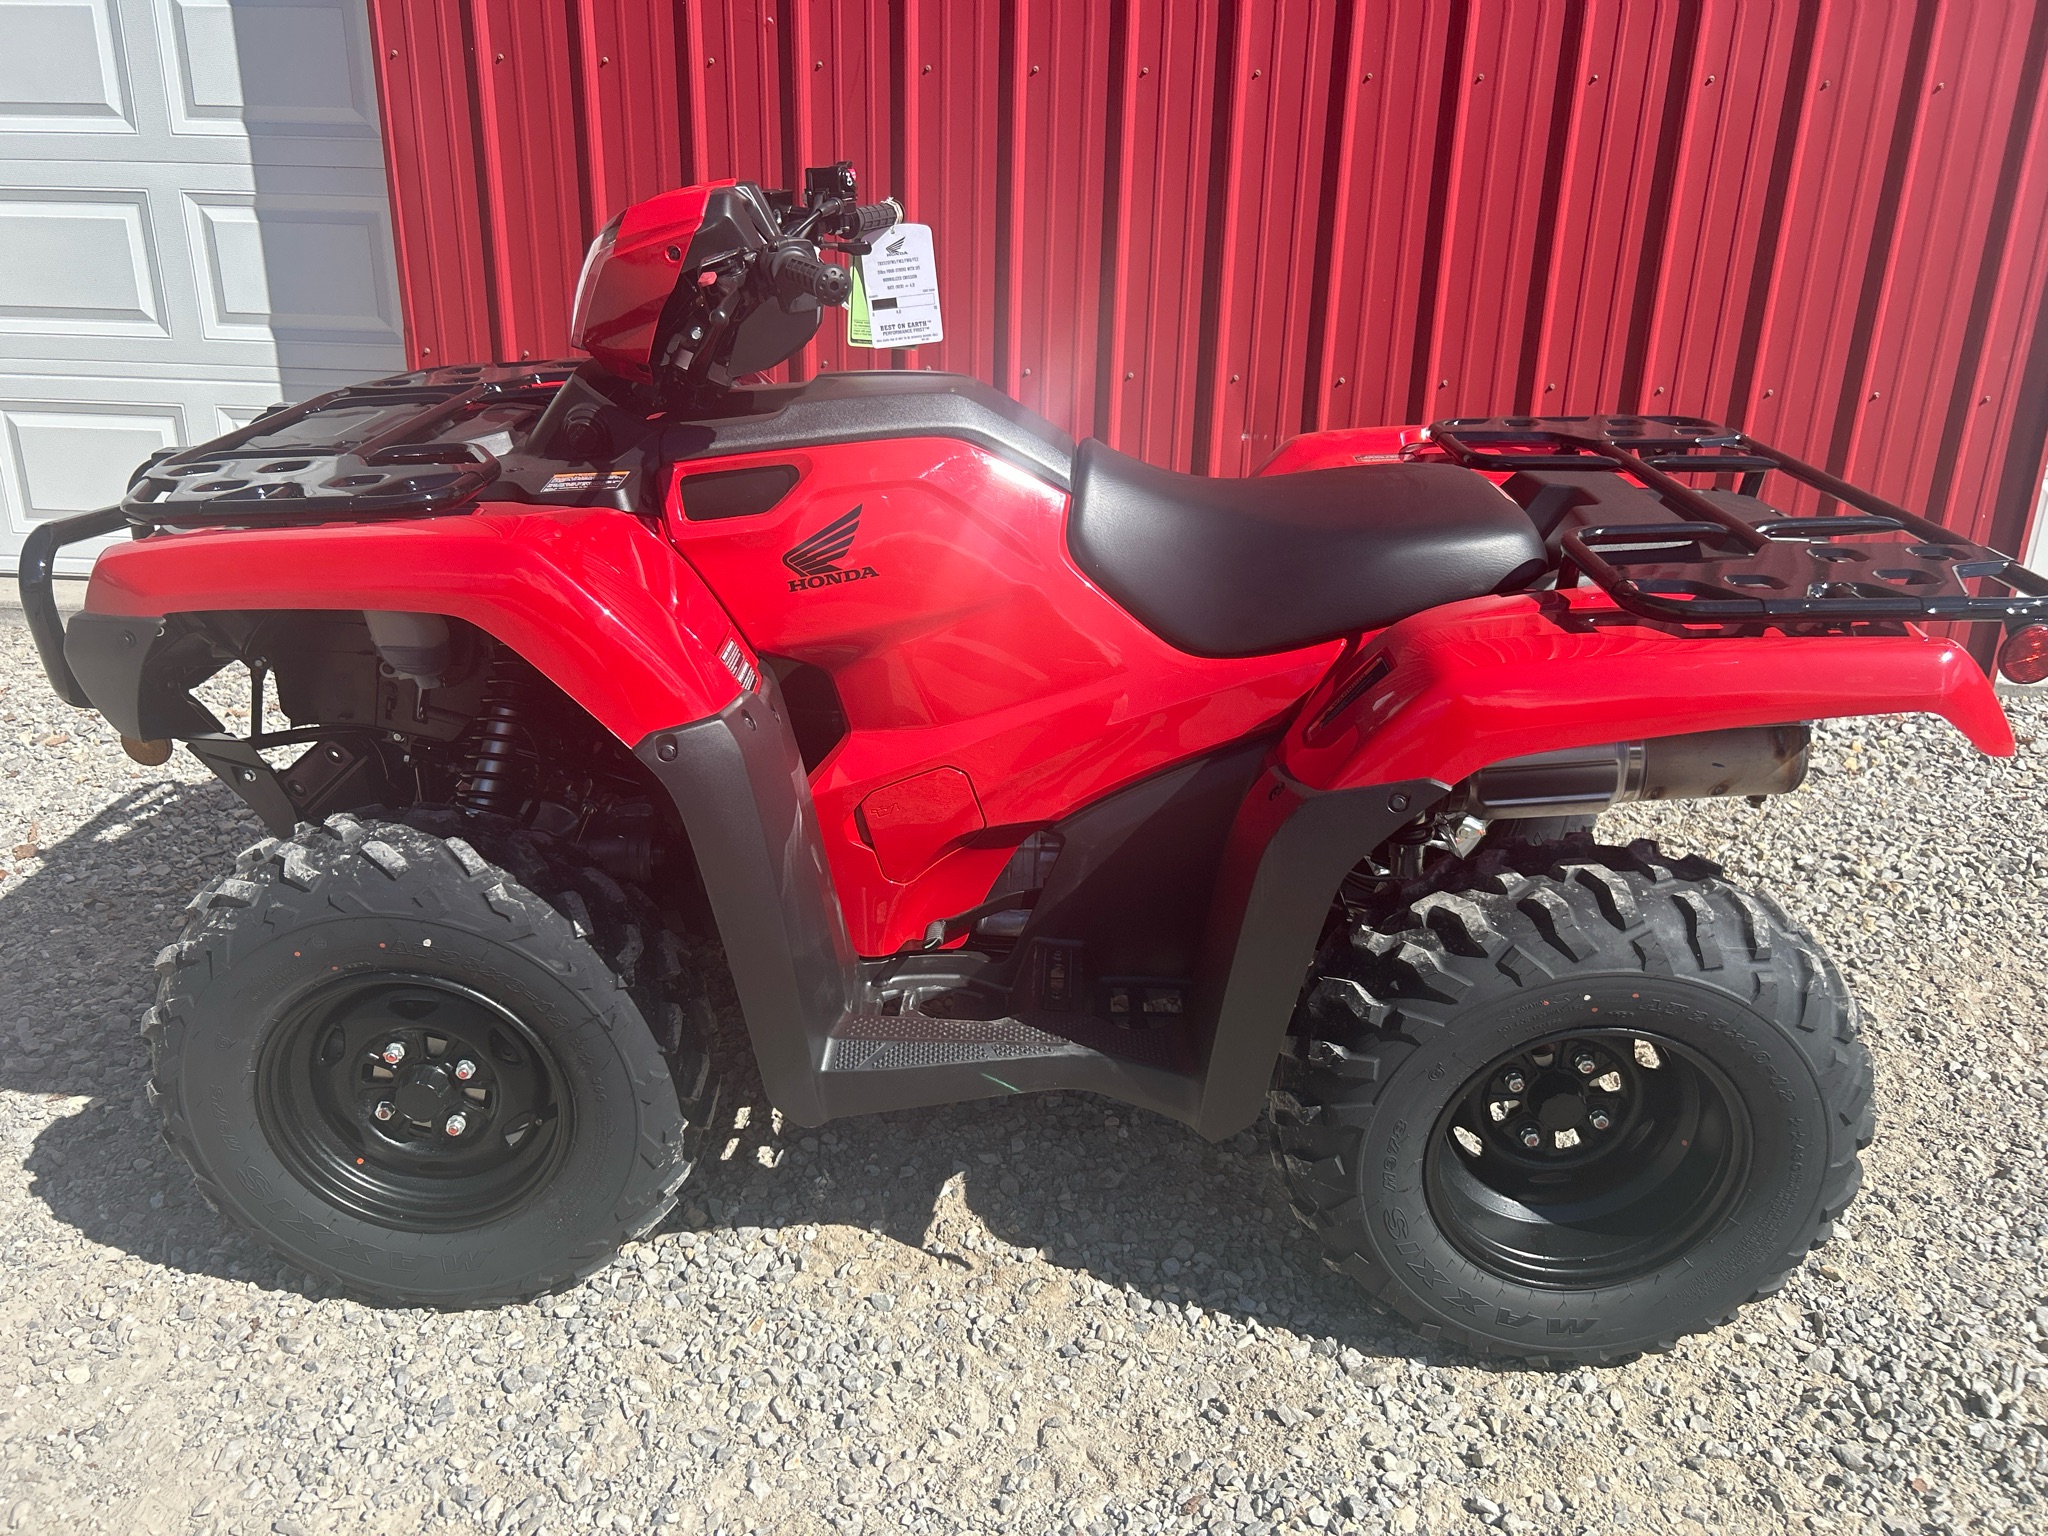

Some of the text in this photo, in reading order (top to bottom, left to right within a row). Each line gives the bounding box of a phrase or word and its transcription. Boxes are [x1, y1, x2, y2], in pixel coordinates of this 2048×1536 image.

[880, 324, 896, 332] BEST
[882, 328, 913, 336] PERFORMANCE
[788, 566, 880, 593] HONDA
[236, 1164, 495, 1275] MAXXIS
[1383, 1206, 1603, 1337] MAXXIS
